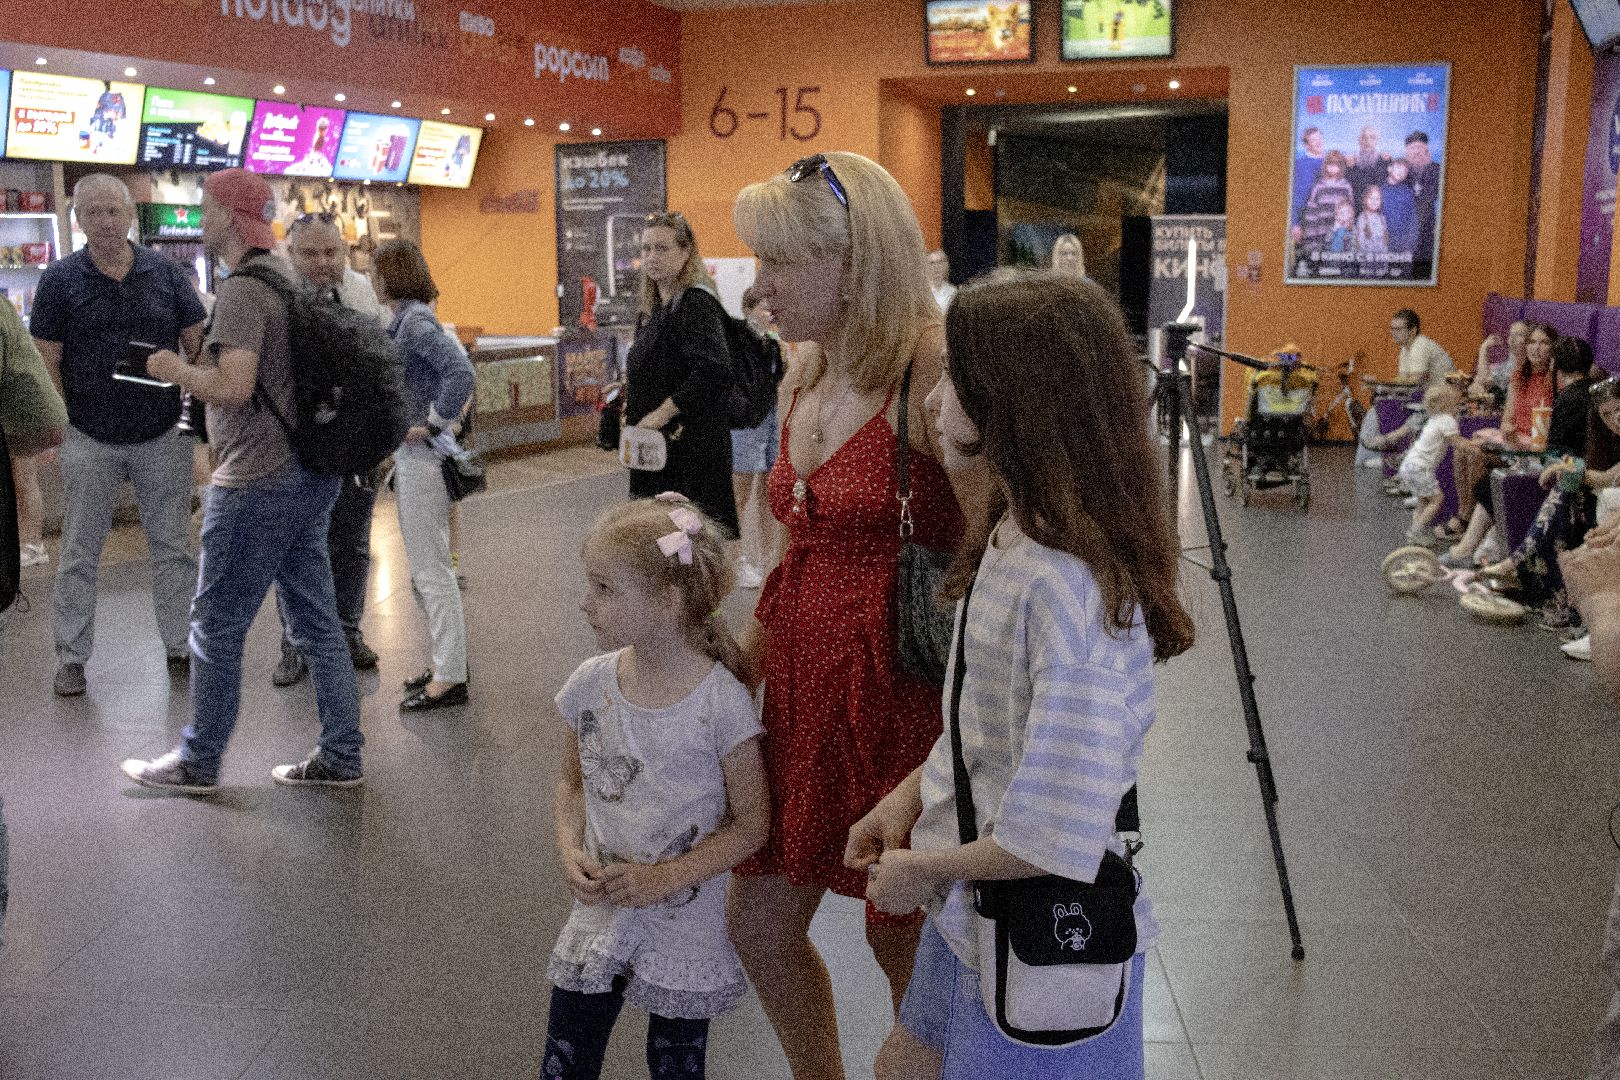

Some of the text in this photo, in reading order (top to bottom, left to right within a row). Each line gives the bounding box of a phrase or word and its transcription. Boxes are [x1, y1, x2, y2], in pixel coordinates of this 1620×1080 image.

[709, 86, 821, 141] 6-15
[159, 224, 203, 236] Heineken
[1154, 240, 1214, 251] БИЛТЫ
